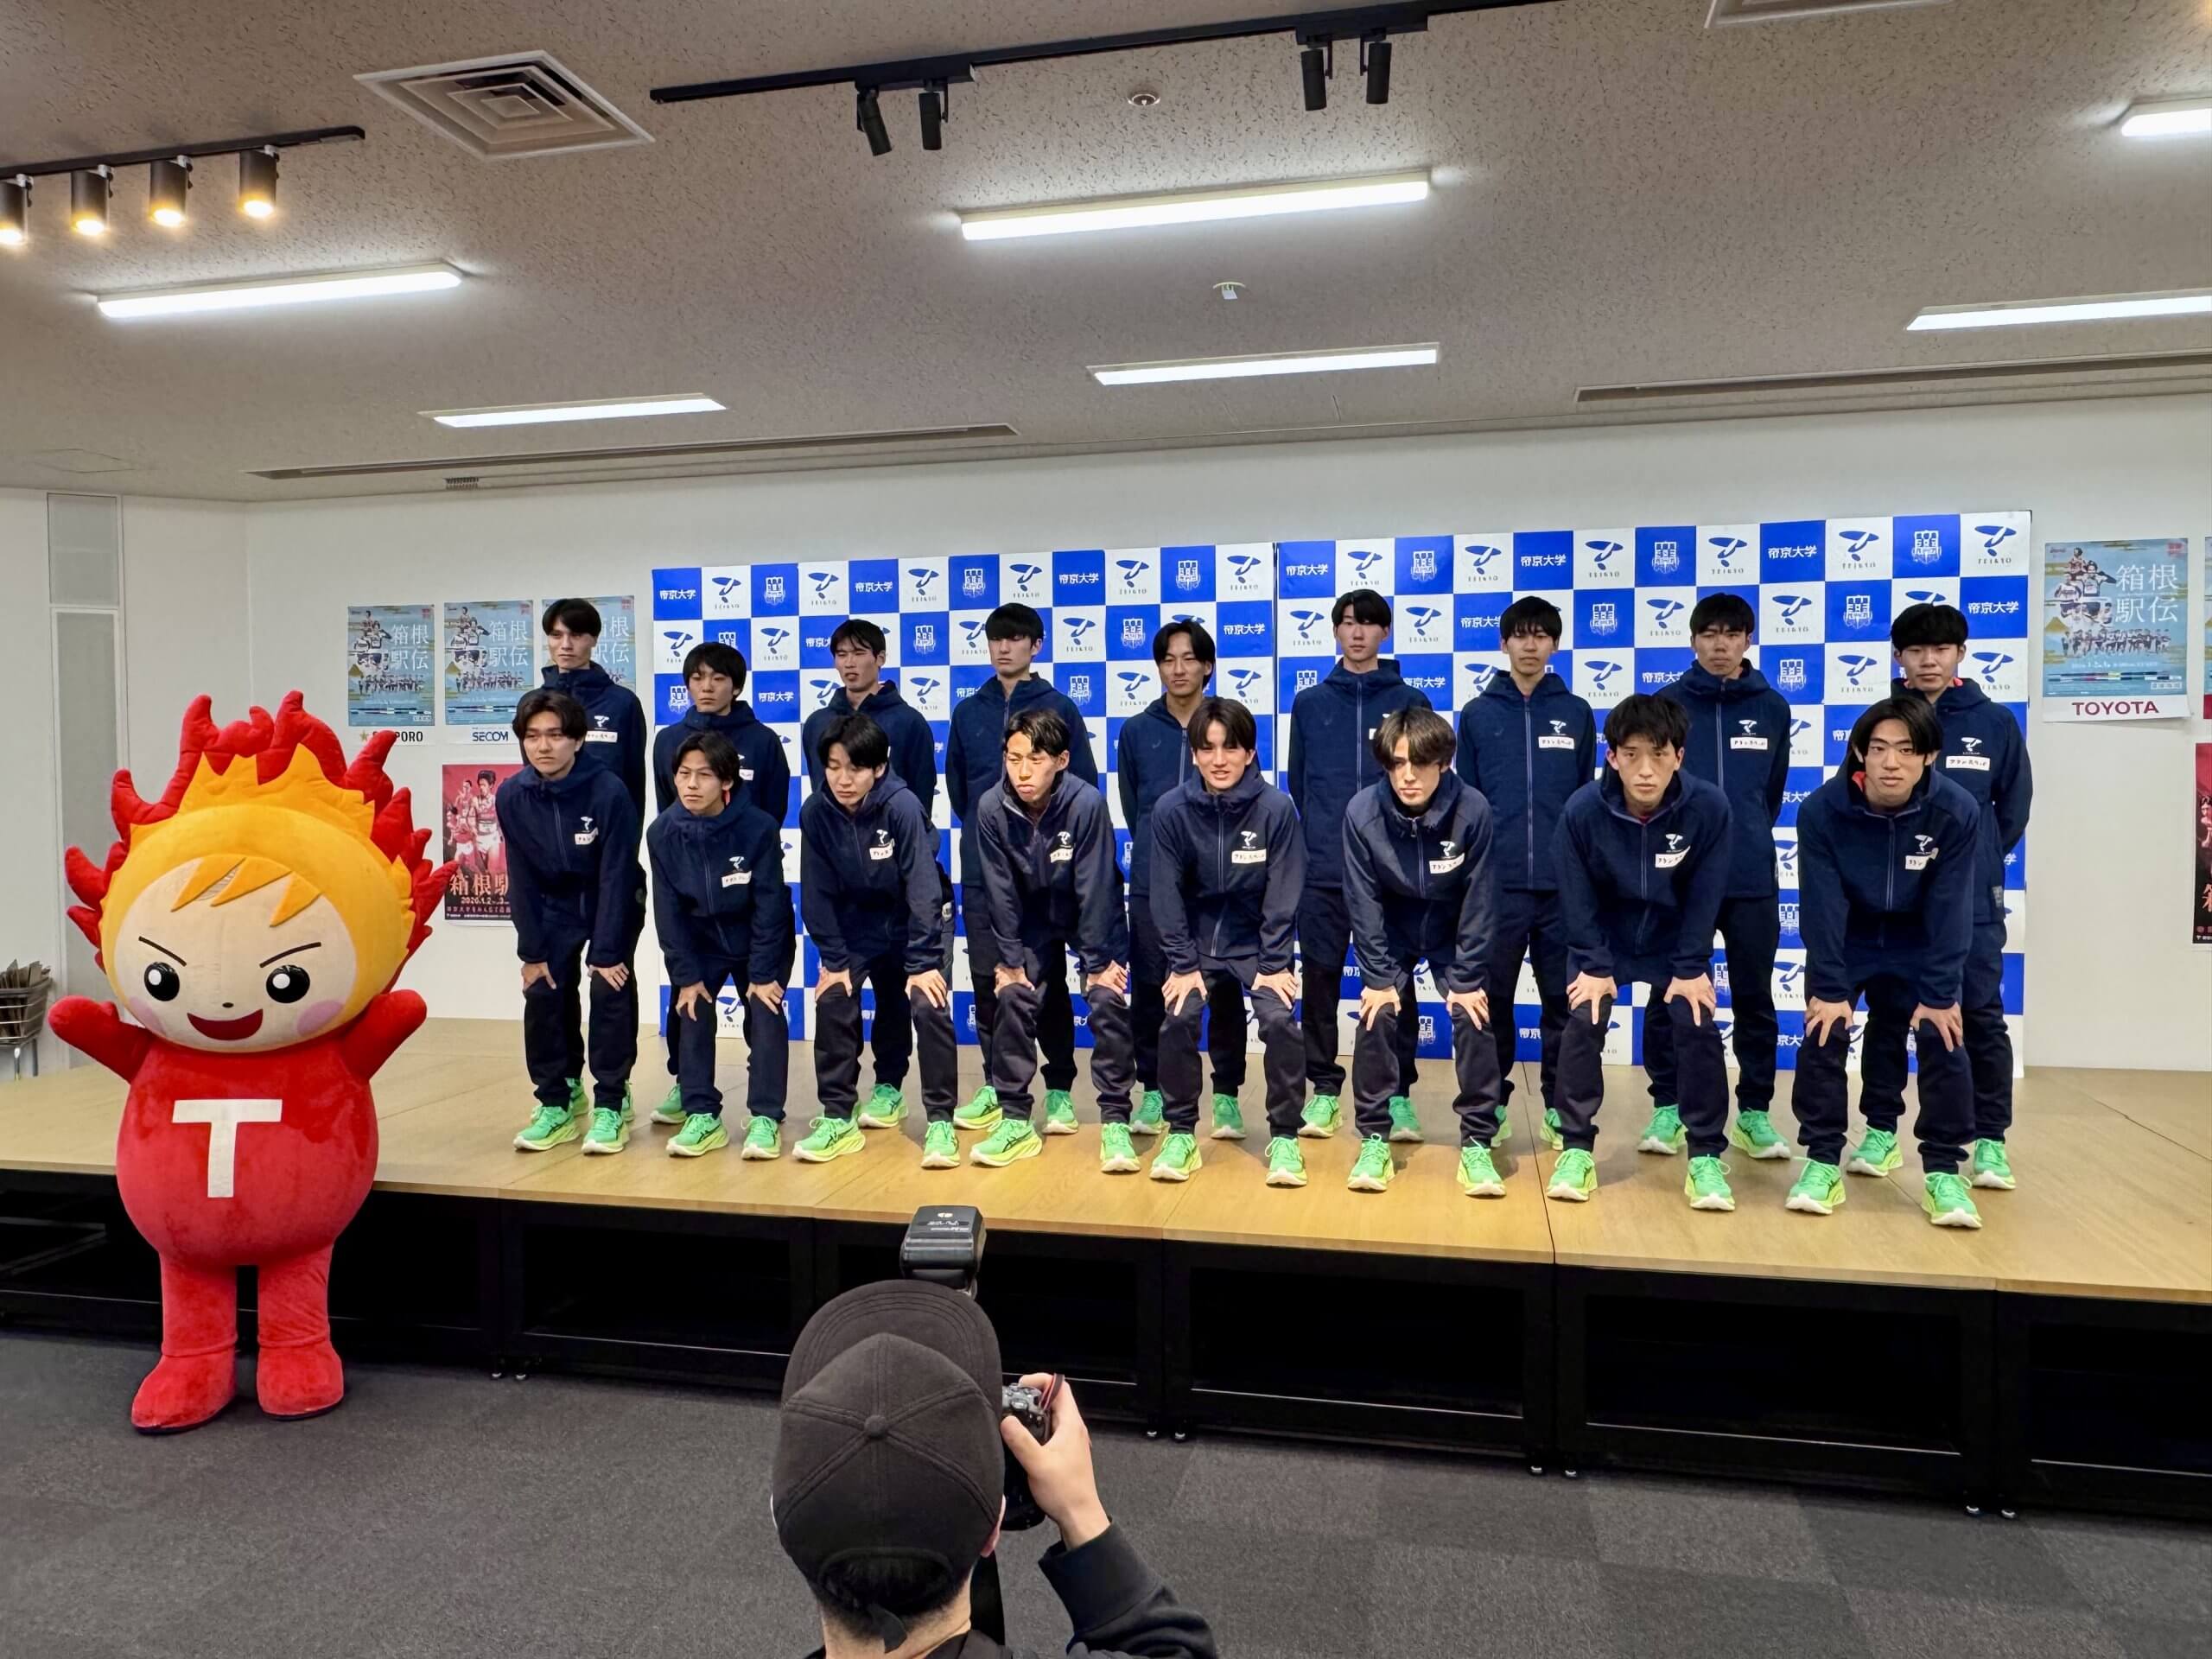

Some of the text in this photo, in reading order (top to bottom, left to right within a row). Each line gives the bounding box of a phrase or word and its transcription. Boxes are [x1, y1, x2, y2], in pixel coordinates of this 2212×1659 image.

[1768, 545, 1817, 559] 帝京大学
[1521, 554, 1567, 567] 帝京大学
[1286, 564, 1328, 576] 帝京大学
[2117, 563, 2178, 591] 箱根
[1059, 573, 1099, 585] 帝京大学
[855, 581, 893, 593] 帝京大学
[659, 589, 696, 600] 帝京大学
[1968, 601, 2019, 614] 帝京大学
[2115, 596, 2178, 623] 駅伝
[391, 624, 429, 645] 箱根
[488, 620, 528, 642] 箱根
[1224, 623, 1265, 635] 帝京大学
[391, 649, 429, 671] 駅伝
[488, 647, 528, 667] 駅伝
[2072, 701, 2159, 715] TOYOTA
[472, 731, 509, 742] SECOM
[172, 1099, 283, 1198] T
